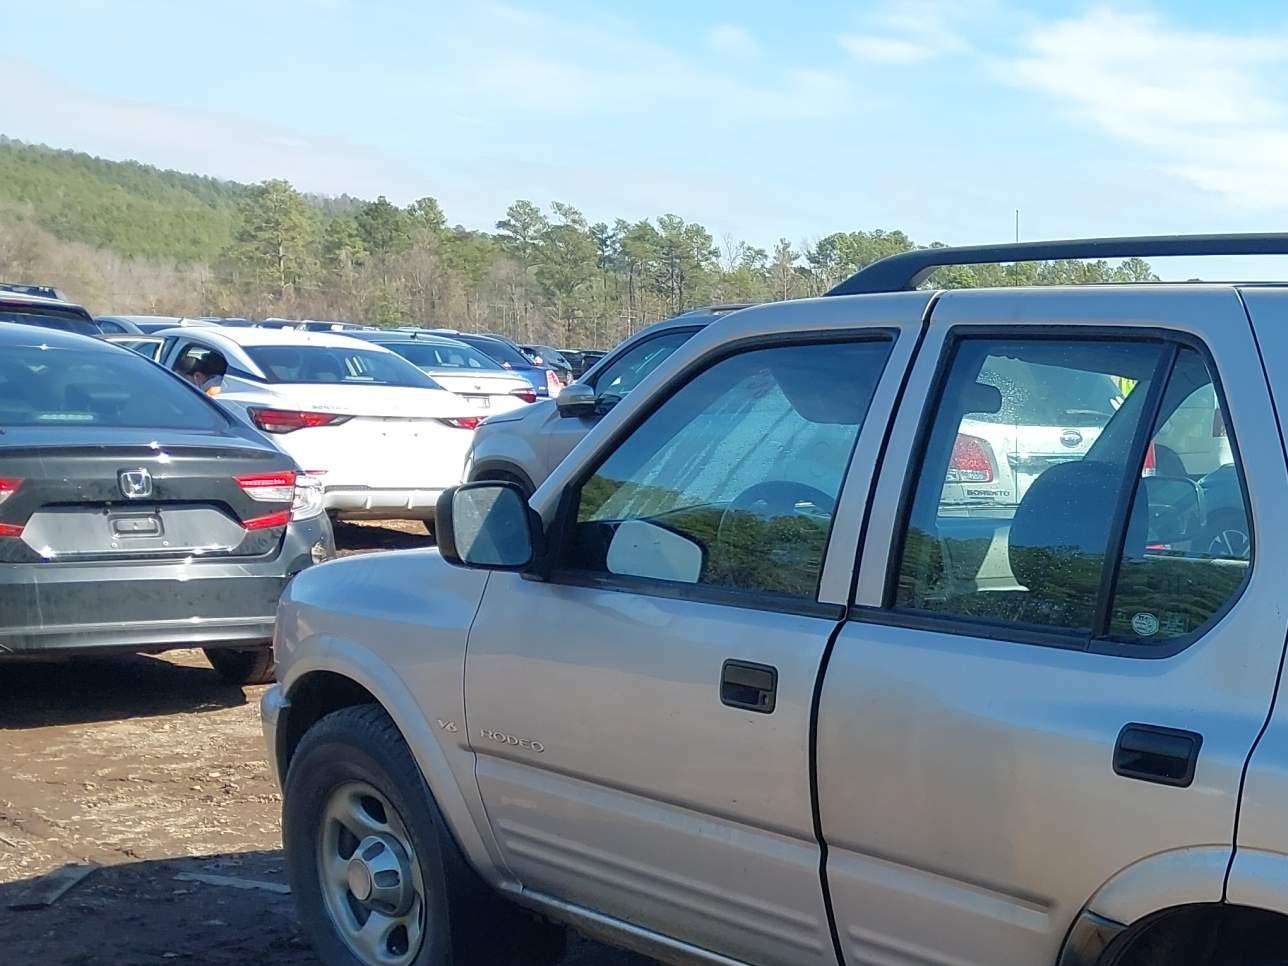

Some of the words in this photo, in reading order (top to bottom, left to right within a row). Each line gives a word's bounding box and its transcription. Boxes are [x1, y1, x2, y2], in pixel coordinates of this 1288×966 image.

[966, 488, 1010, 497] SORENTO
[437, 719, 458, 733] V6
[480, 729, 545, 753] RODEO
